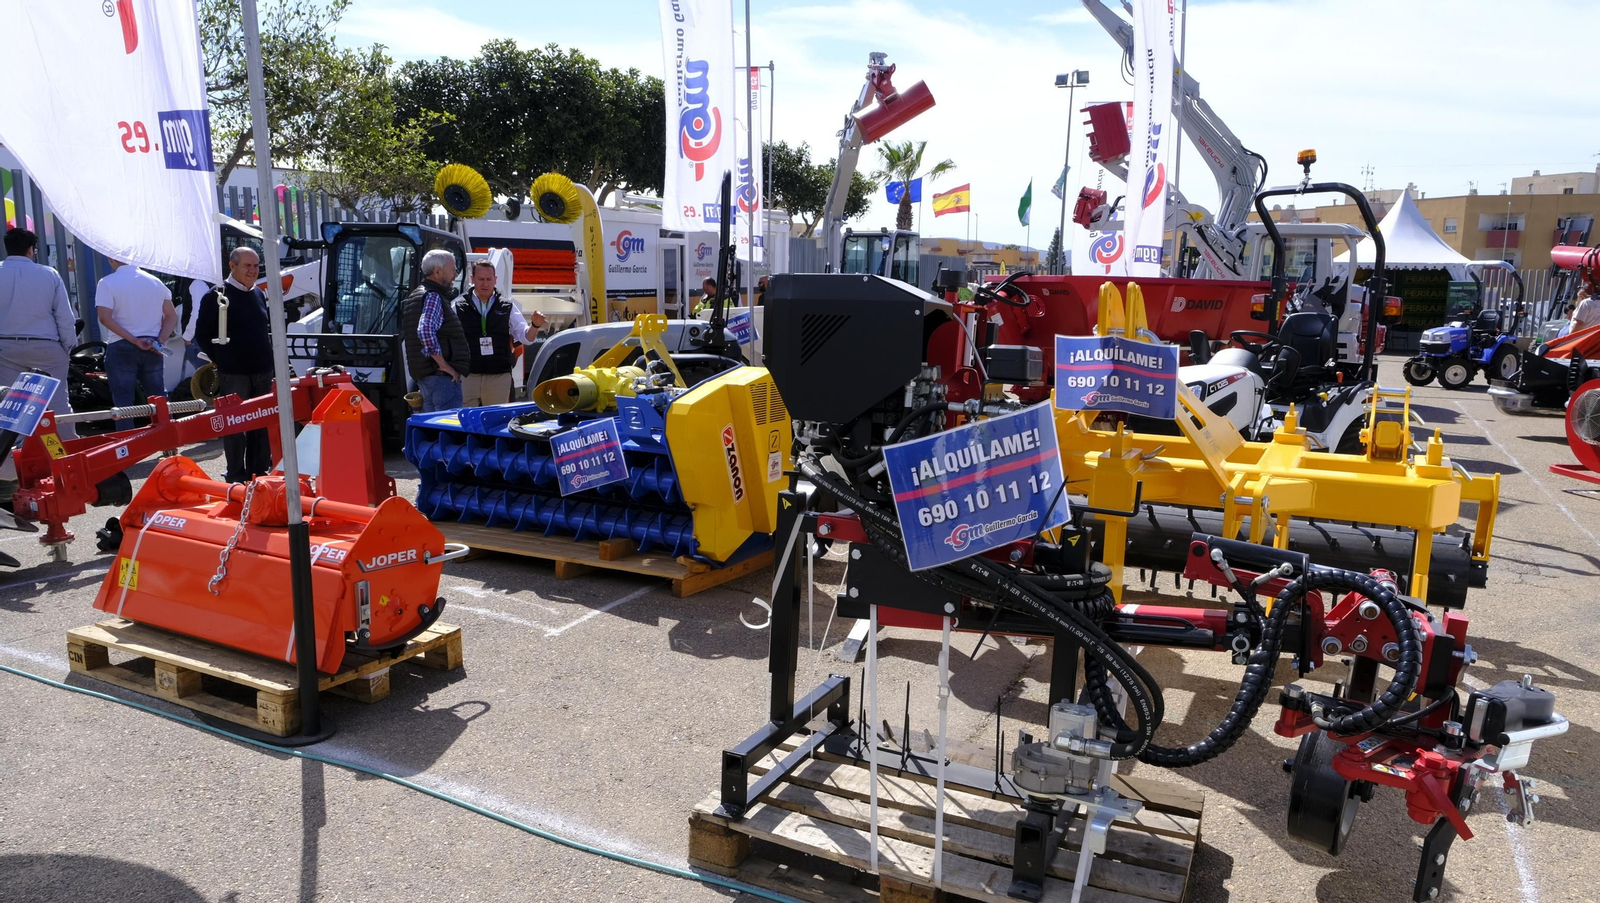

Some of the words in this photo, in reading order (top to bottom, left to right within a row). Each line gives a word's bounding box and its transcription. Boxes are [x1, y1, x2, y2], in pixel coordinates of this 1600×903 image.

[1187, 300, 1222, 310] DAVID
[1070, 346, 1163, 370] ¡ALQUÍLAME!
[1067, 376, 1096, 388] 690
[1101, 375, 1120, 388] 10
[1125, 378, 1140, 392] 11
[1147, 383, 1165, 396] 12
[12, 402, 23, 412] 11
[23, 404, 36, 416] 12
[558, 431, 608, 457] ¡ALQUÍLAME!
[561, 463, 577, 476] 690
[578, 459, 590, 470] 10
[591, 455, 601, 467] 11
[603, 451, 616, 463] 12
[911, 428, 1041, 487] ¡ALQUÍLAME!
[918, 499, 959, 527] 690
[964, 490, 990, 513] 10
[995, 481, 1020, 503] 11
[1028, 471, 1051, 495] 12
[984, 518, 1016, 533] Guillermo
[366, 549, 417, 569] JOPER
[1047, 611, 1060, 622] 25.4
[1060, 620, 1069, 628] mm
[1105, 654, 1113, 663] 88
[1112, 661, 1121, 670] bar
